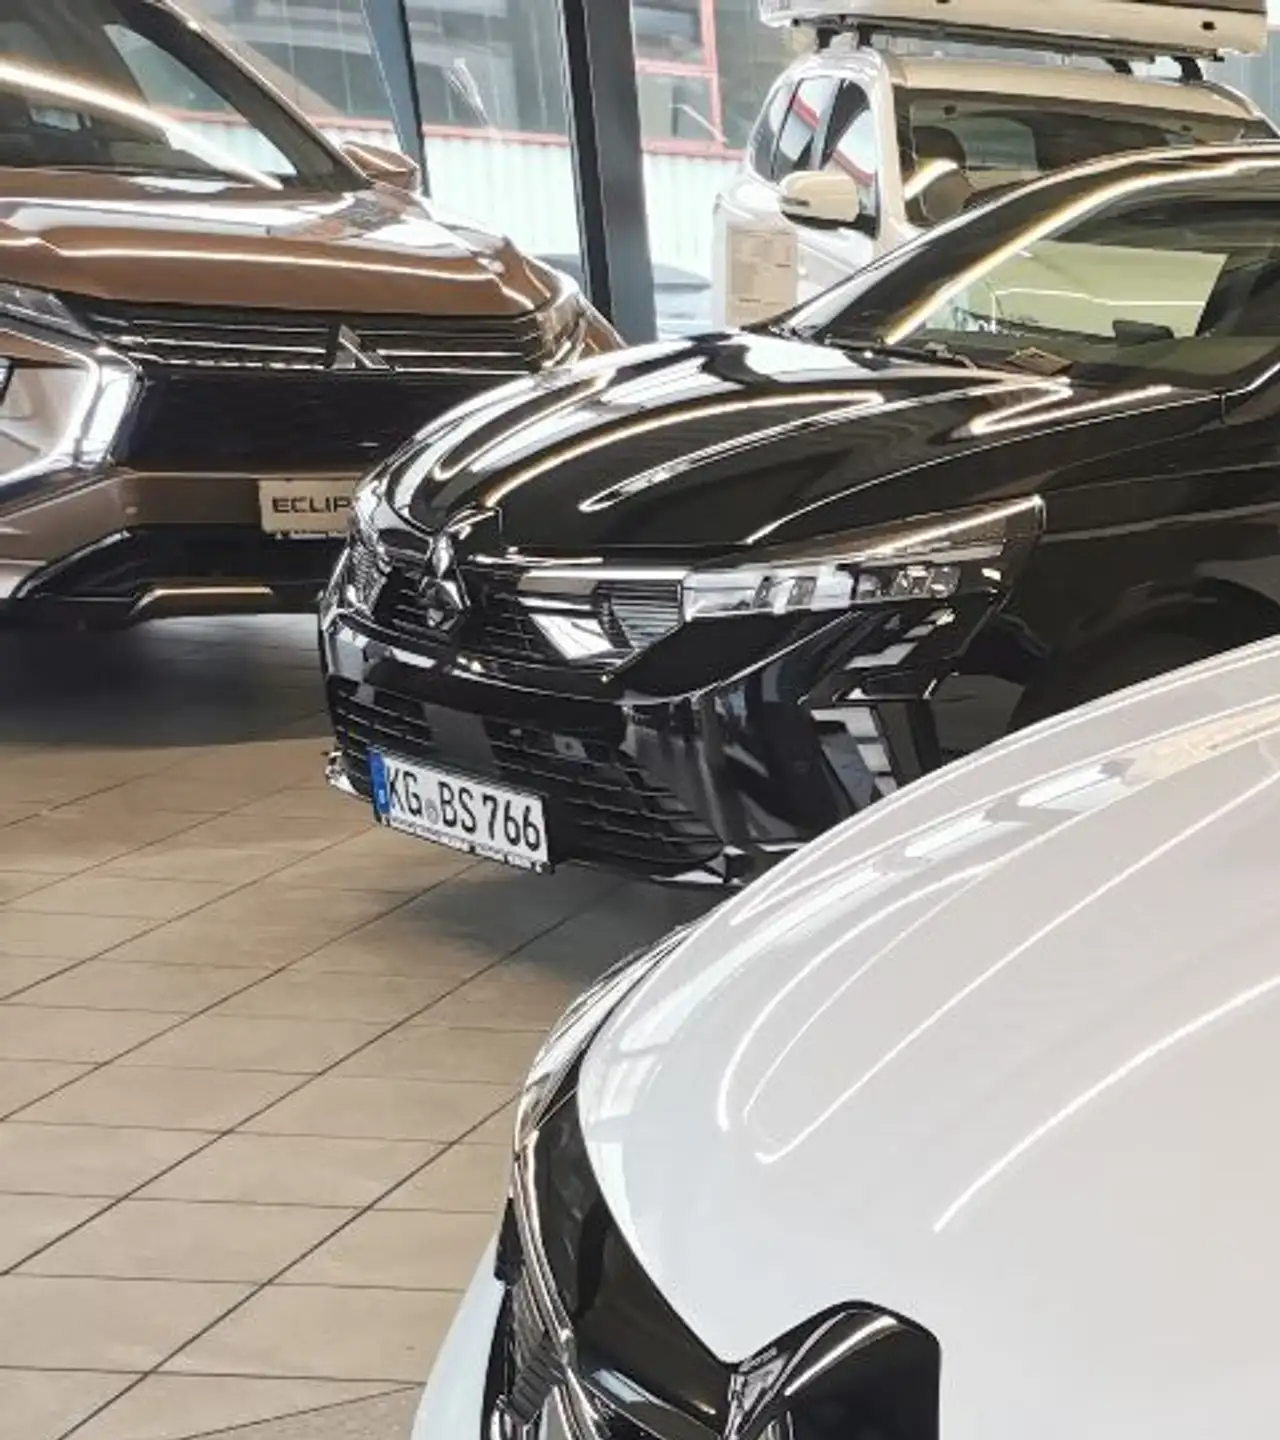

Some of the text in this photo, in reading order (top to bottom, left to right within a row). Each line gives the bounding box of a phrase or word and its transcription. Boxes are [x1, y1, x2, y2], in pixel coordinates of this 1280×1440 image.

[272, 495, 354, 513] ECLIP
[387, 766, 424, 818] KG
[438, 781, 477, 834] BS
[482, 793, 540, 851] 766
